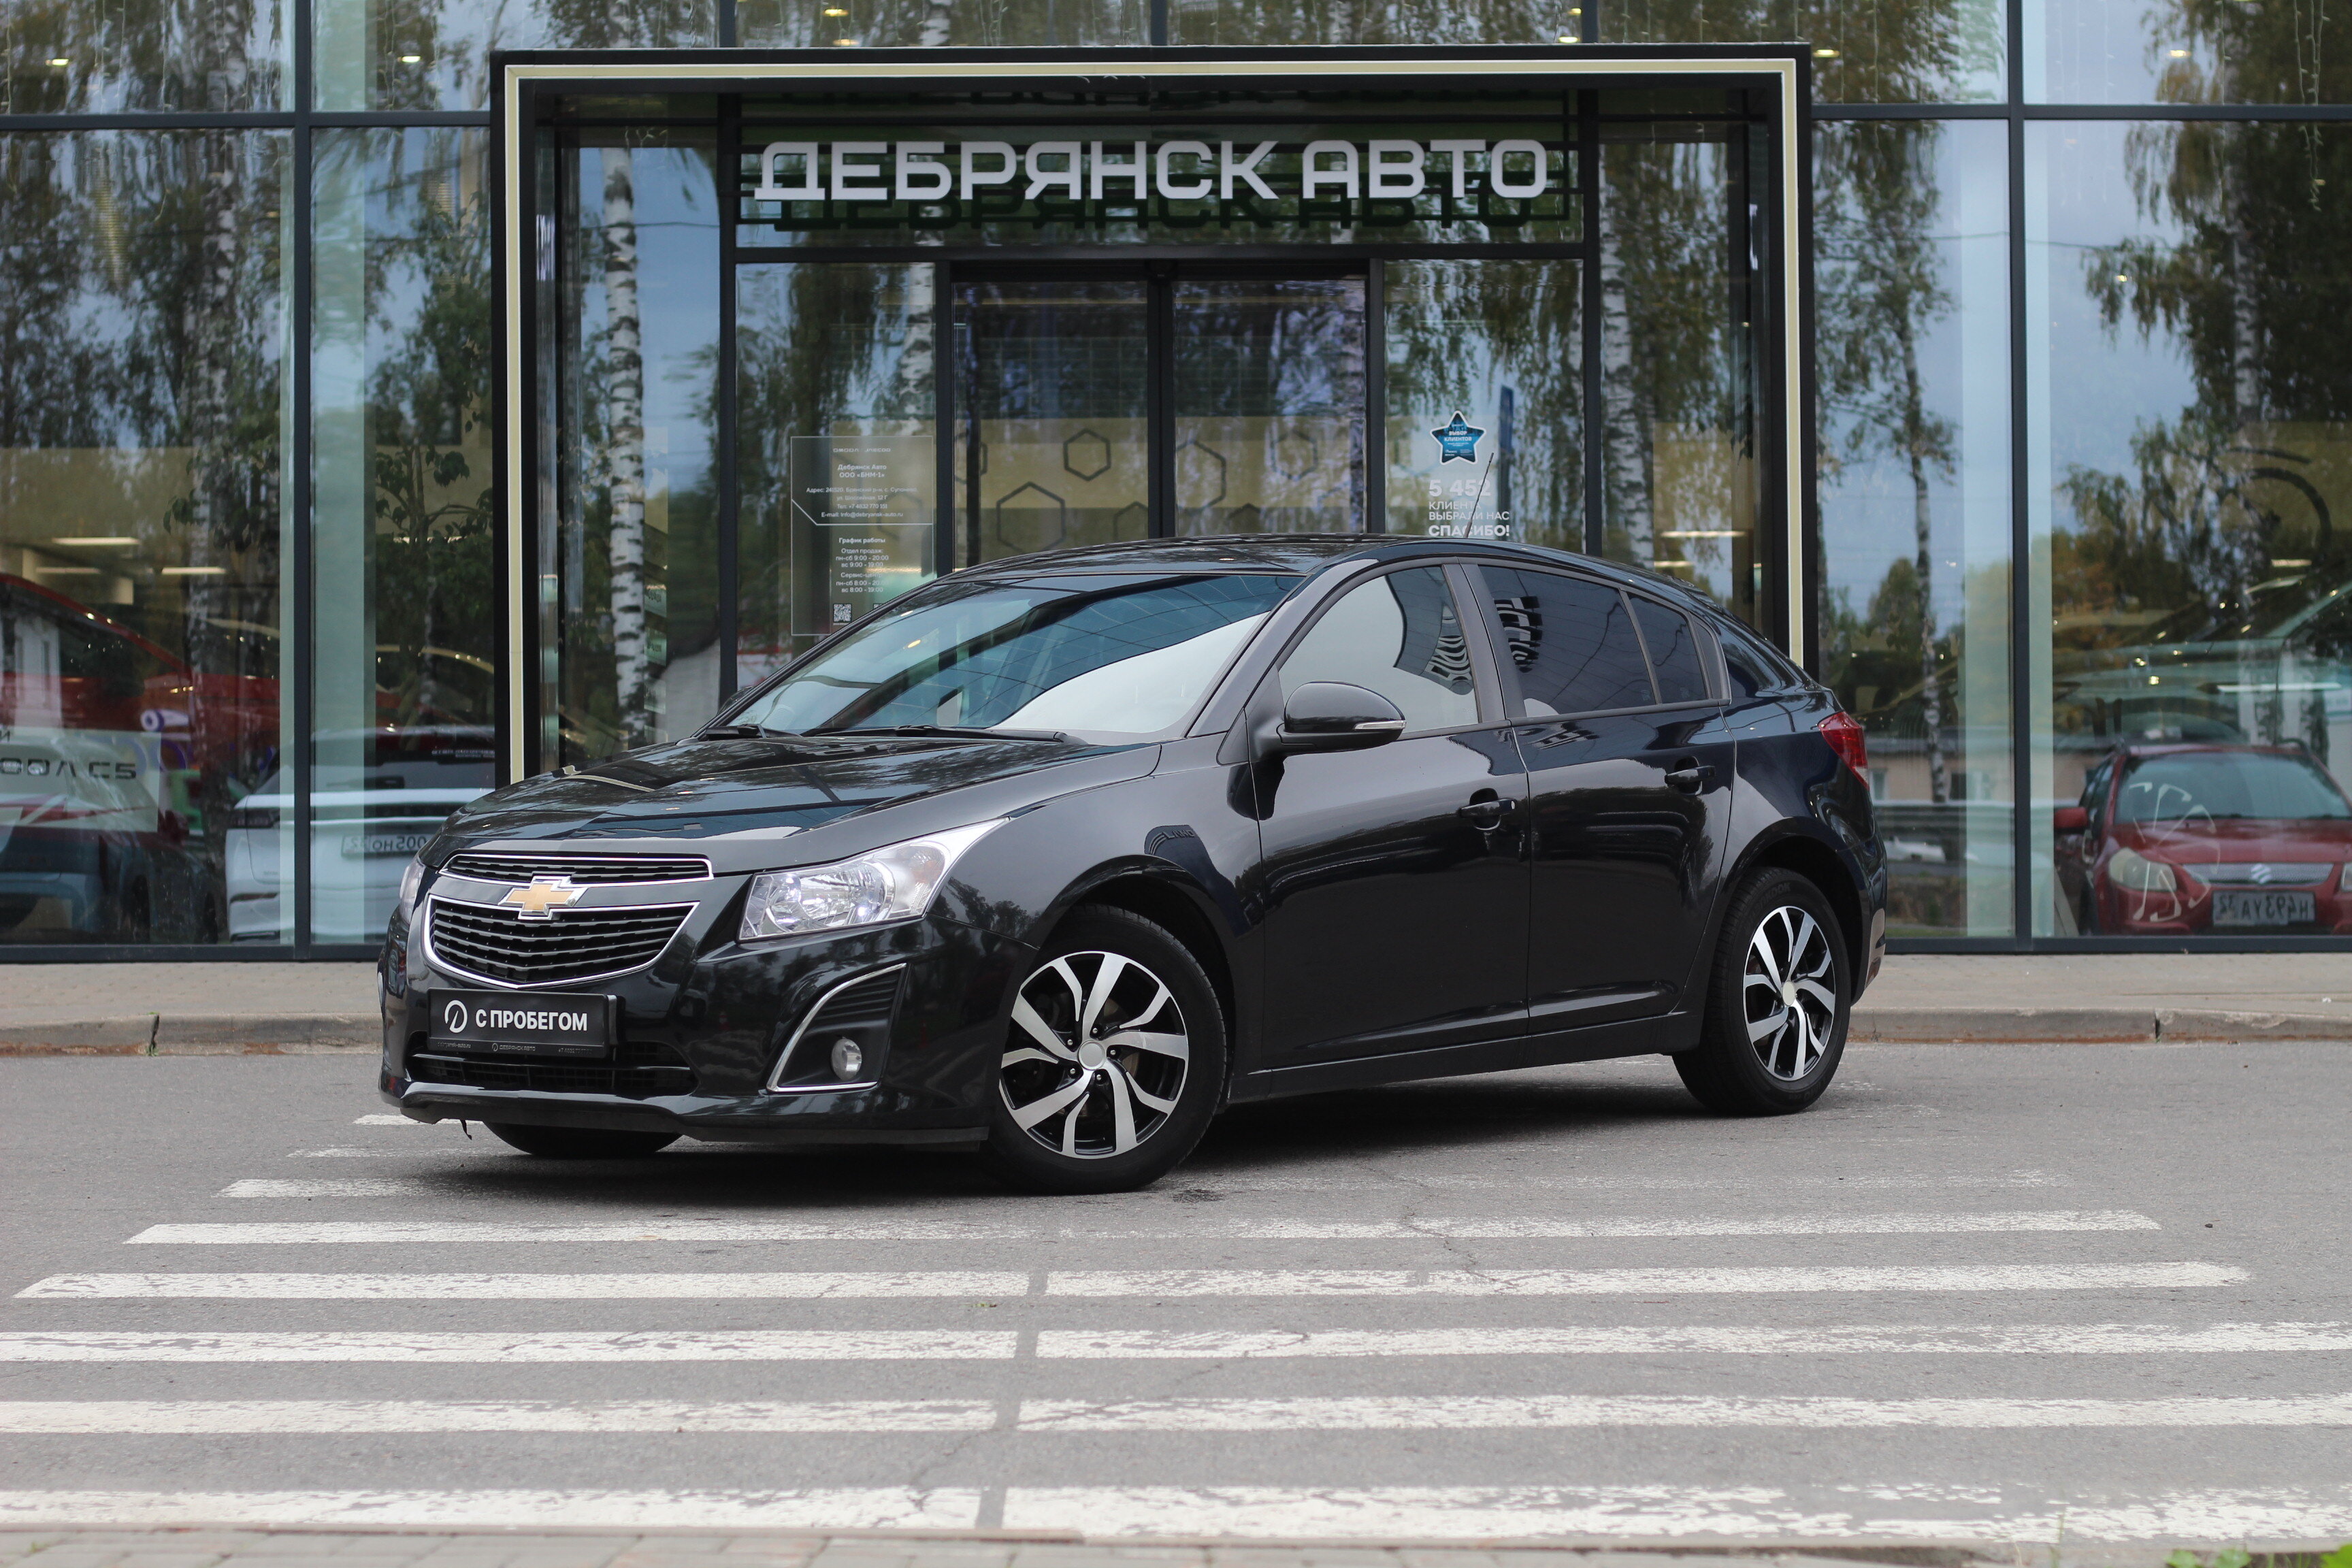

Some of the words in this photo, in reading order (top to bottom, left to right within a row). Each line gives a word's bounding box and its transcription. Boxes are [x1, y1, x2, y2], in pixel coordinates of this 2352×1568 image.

[754, 140, 1279, 200] ДЕБРЯНСК
[1303, 140, 1547, 199] АВТО
[1429, 479, 1442, 497] 5
[1450, 479, 1491, 497] 452
[1429, 501, 1481, 510] КЛИЕНТА
[1429, 512, 1483, 521] ВЫБРАЛИ
[1487, 511, 1509, 520] НАС
[476, 1009, 487, 1028] С
[490, 1009, 588, 1032] ПРОБЕГОМ
